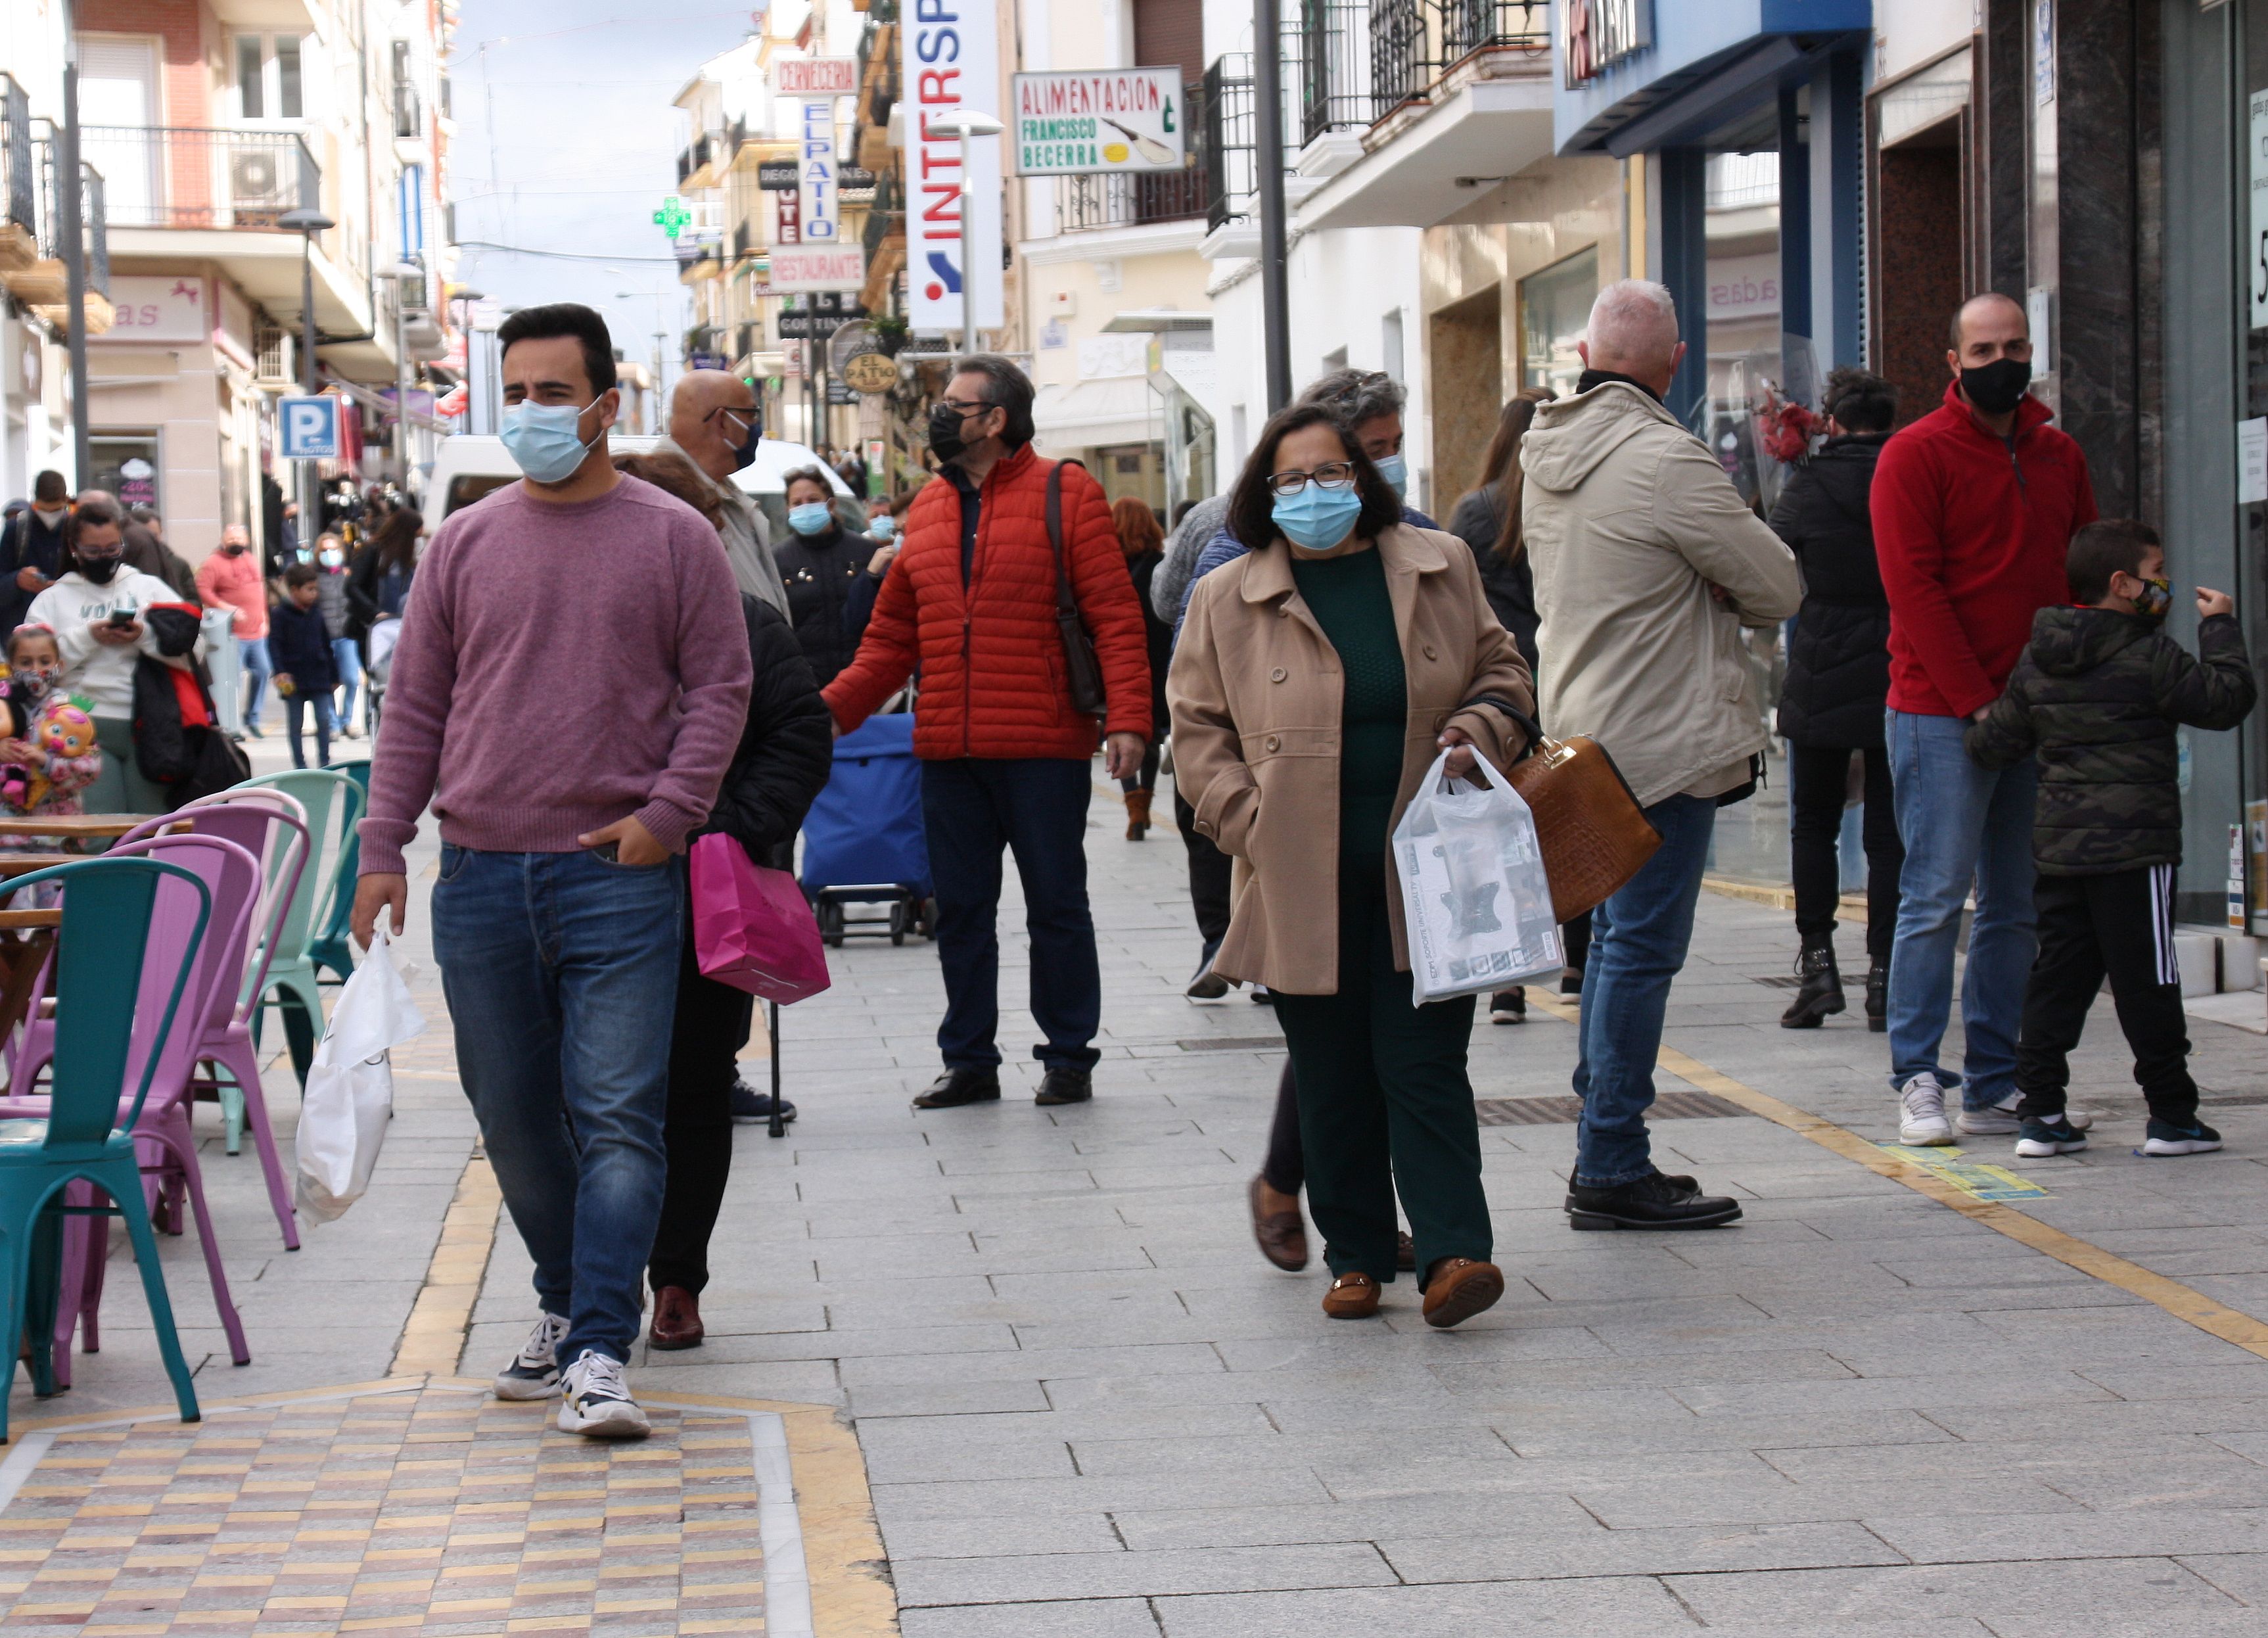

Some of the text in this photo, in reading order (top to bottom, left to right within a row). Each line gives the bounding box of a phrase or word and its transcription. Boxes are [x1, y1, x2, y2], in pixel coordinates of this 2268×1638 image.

[1023, 75, 1160, 115] ALIMENTACION
[1022, 117, 1097, 141] FRANCISCO
[1023, 143, 1098, 168] BECERRA
[773, 252, 861, 281] RESTAURANTE
[846, 367, 896, 379] PATIO
[861, 356, 879, 367] EL
[290, 404, 325, 452] P
[1412, 891, 1425, 927] UNIVERSAL
[1420, 929, 1432, 959] SOPORTE
